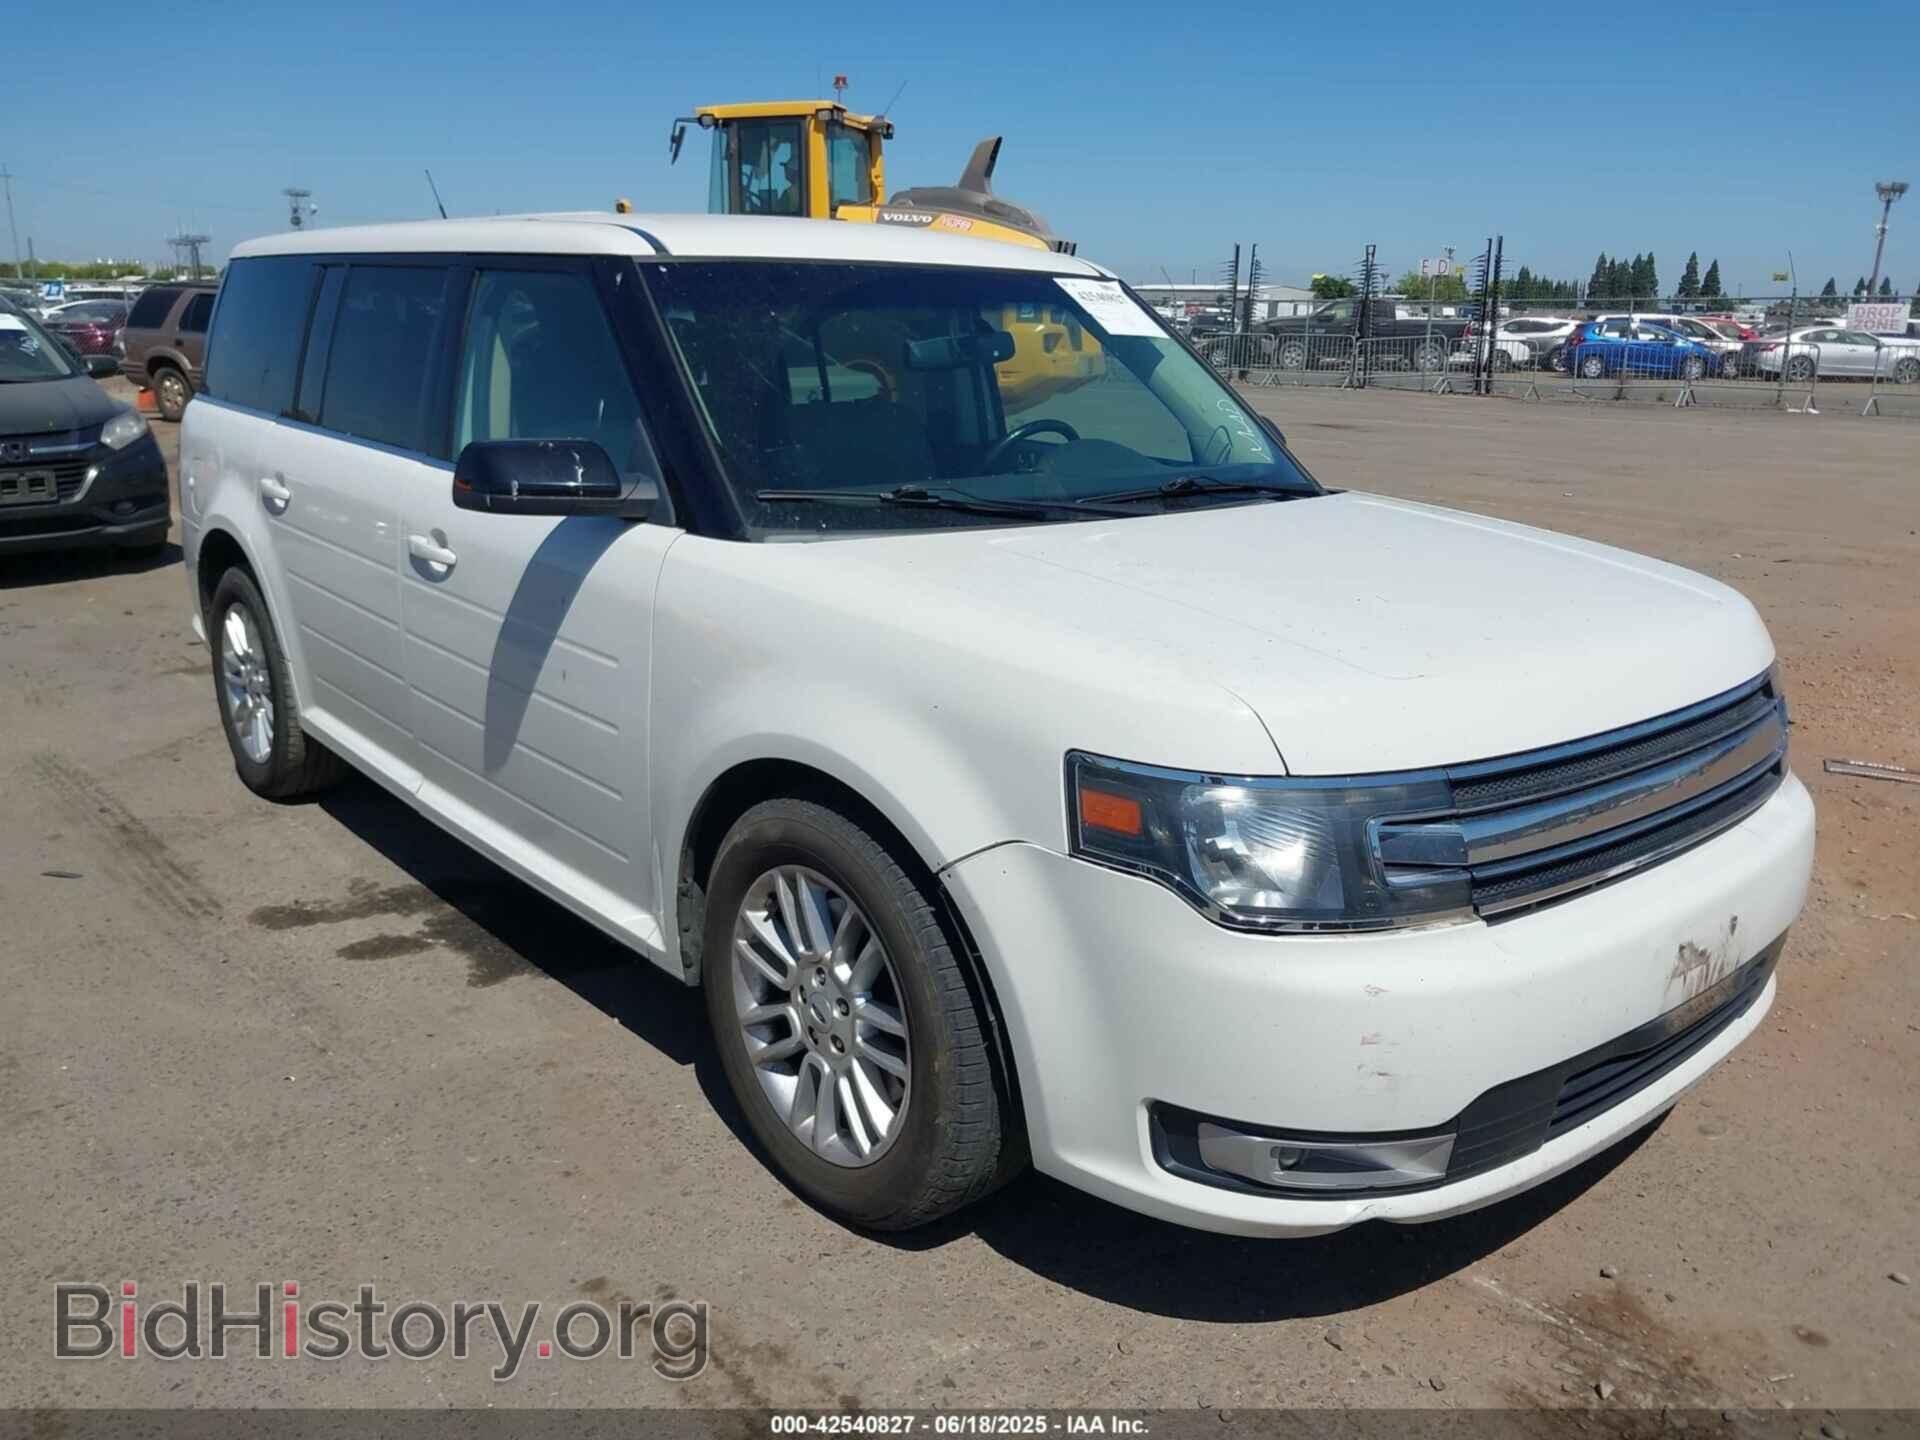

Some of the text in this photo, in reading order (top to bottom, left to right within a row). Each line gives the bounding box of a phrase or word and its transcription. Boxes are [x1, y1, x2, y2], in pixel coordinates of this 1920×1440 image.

[882, 213, 933, 223] VOLVO
[1855, 306, 1903, 318] DROP
[1855, 319, 1902, 330] ZONE
